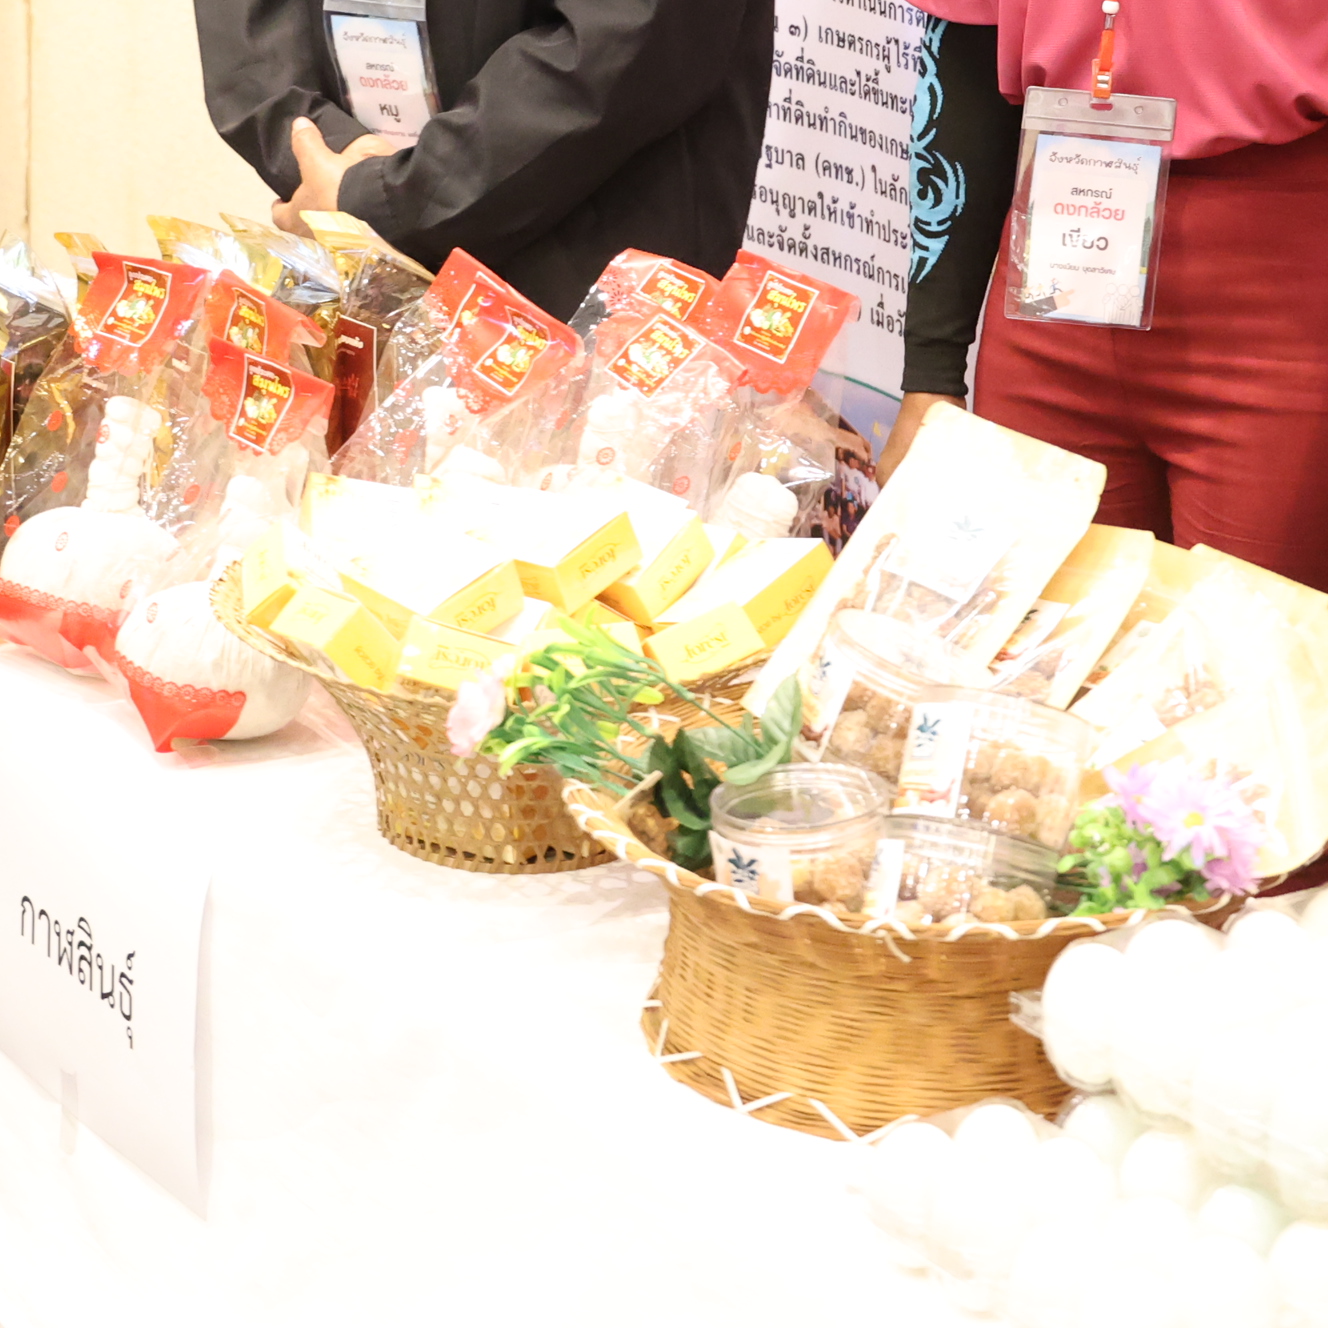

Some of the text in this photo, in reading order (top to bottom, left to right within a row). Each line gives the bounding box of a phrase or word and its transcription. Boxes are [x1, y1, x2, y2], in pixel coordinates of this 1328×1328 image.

[379, 103, 400, 123] หมู
[1070, 187, 1113, 200] สหกรณ์
[1053, 201, 1126, 222] ดงกล้วย
[21, 895, 135, 1050] กาฬสินธุ์
